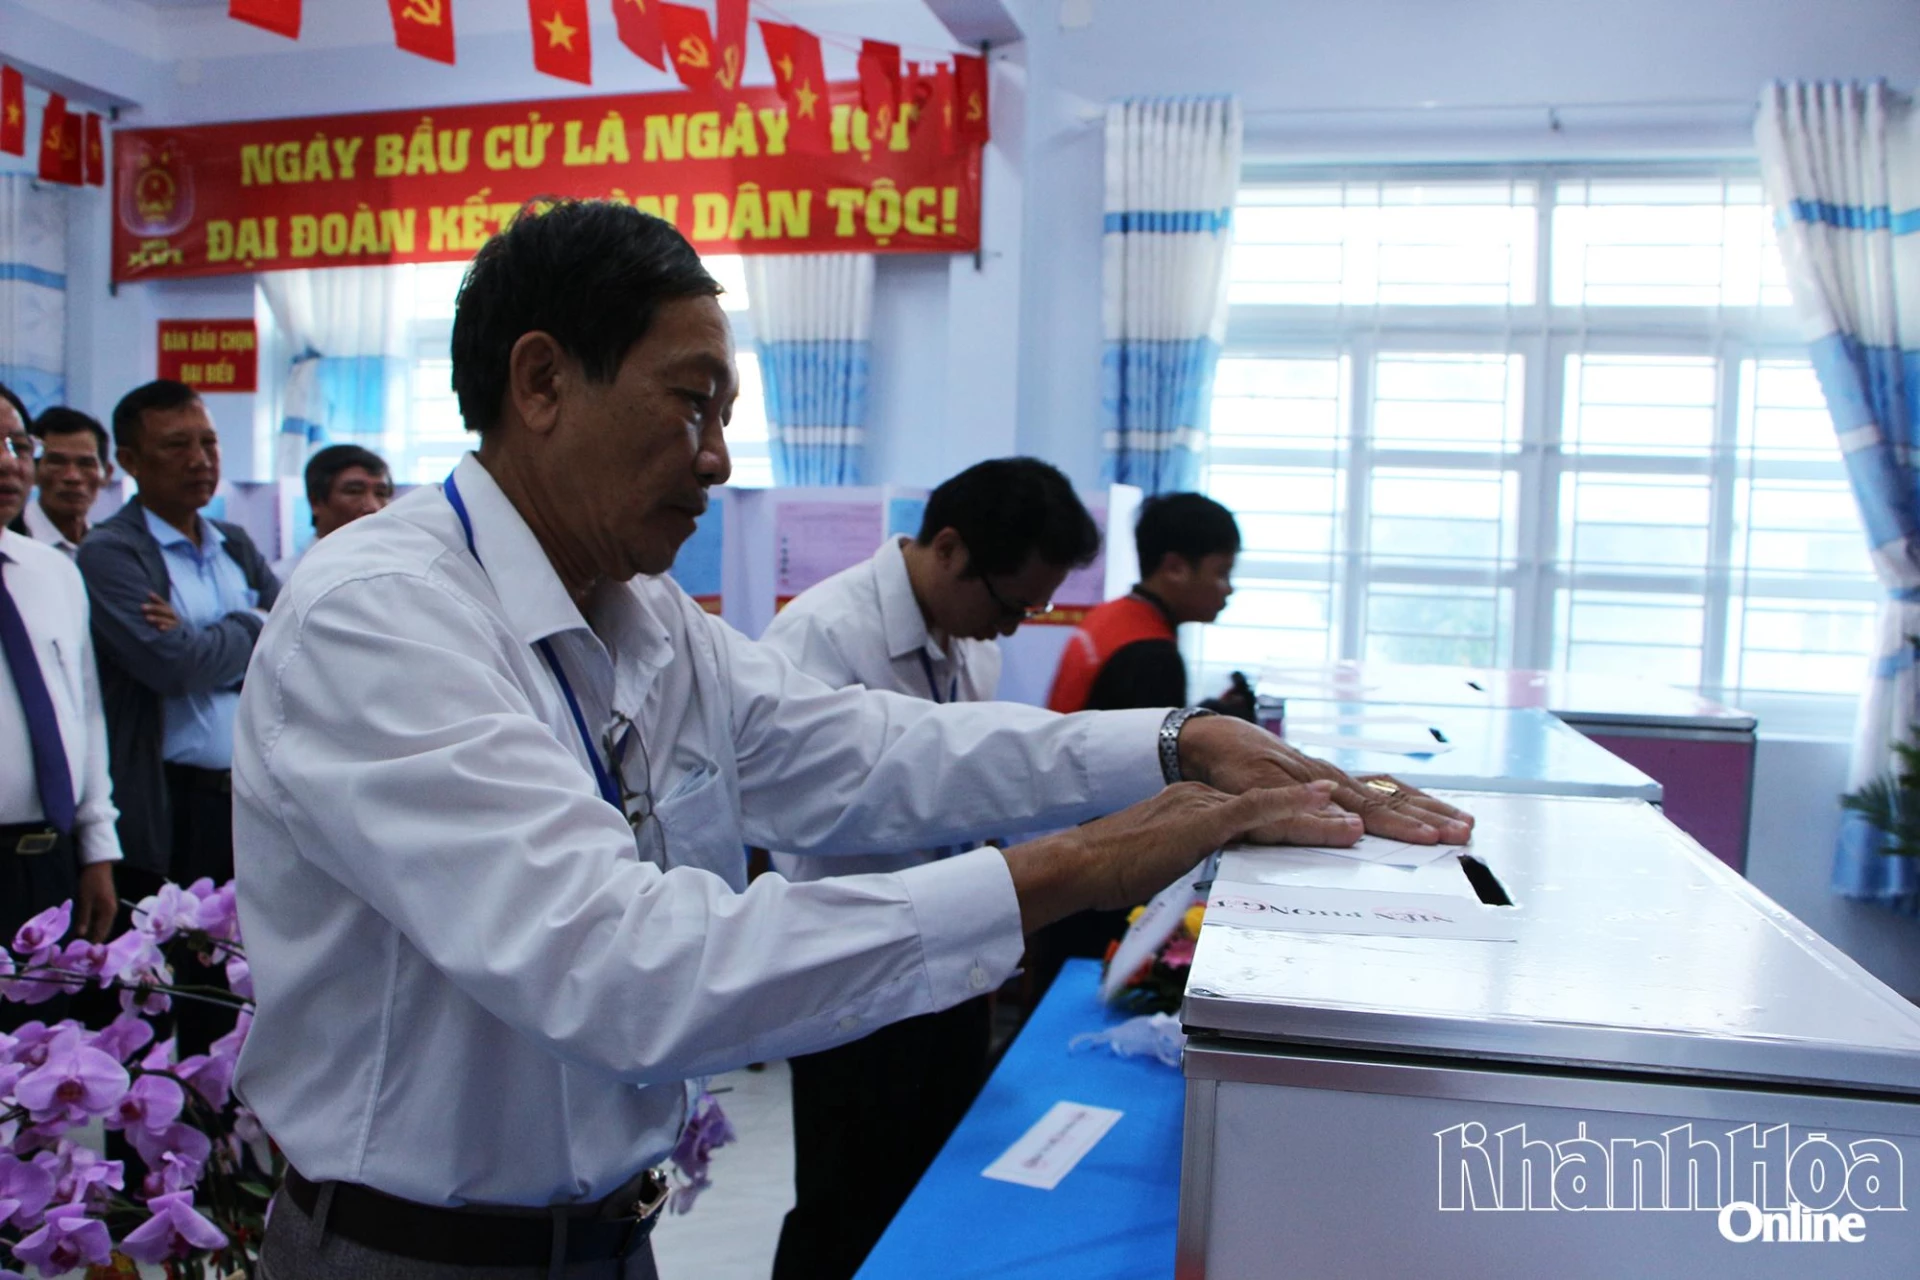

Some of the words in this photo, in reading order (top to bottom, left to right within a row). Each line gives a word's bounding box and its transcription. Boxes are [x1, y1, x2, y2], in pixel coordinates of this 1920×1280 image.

[241, 133, 362, 186] NGÀY
[375, 116, 472, 178] BẦU
[484, 112, 554, 170] CỬ
[563, 110, 630, 166] LÀ
[643, 102, 790, 161] NGÀY
[207, 217, 278, 268] ĐẠI
[291, 203, 417, 258] ĐOÀN
[692, 182, 812, 241] DÂN
[826, 178, 959, 246] TỘC!
